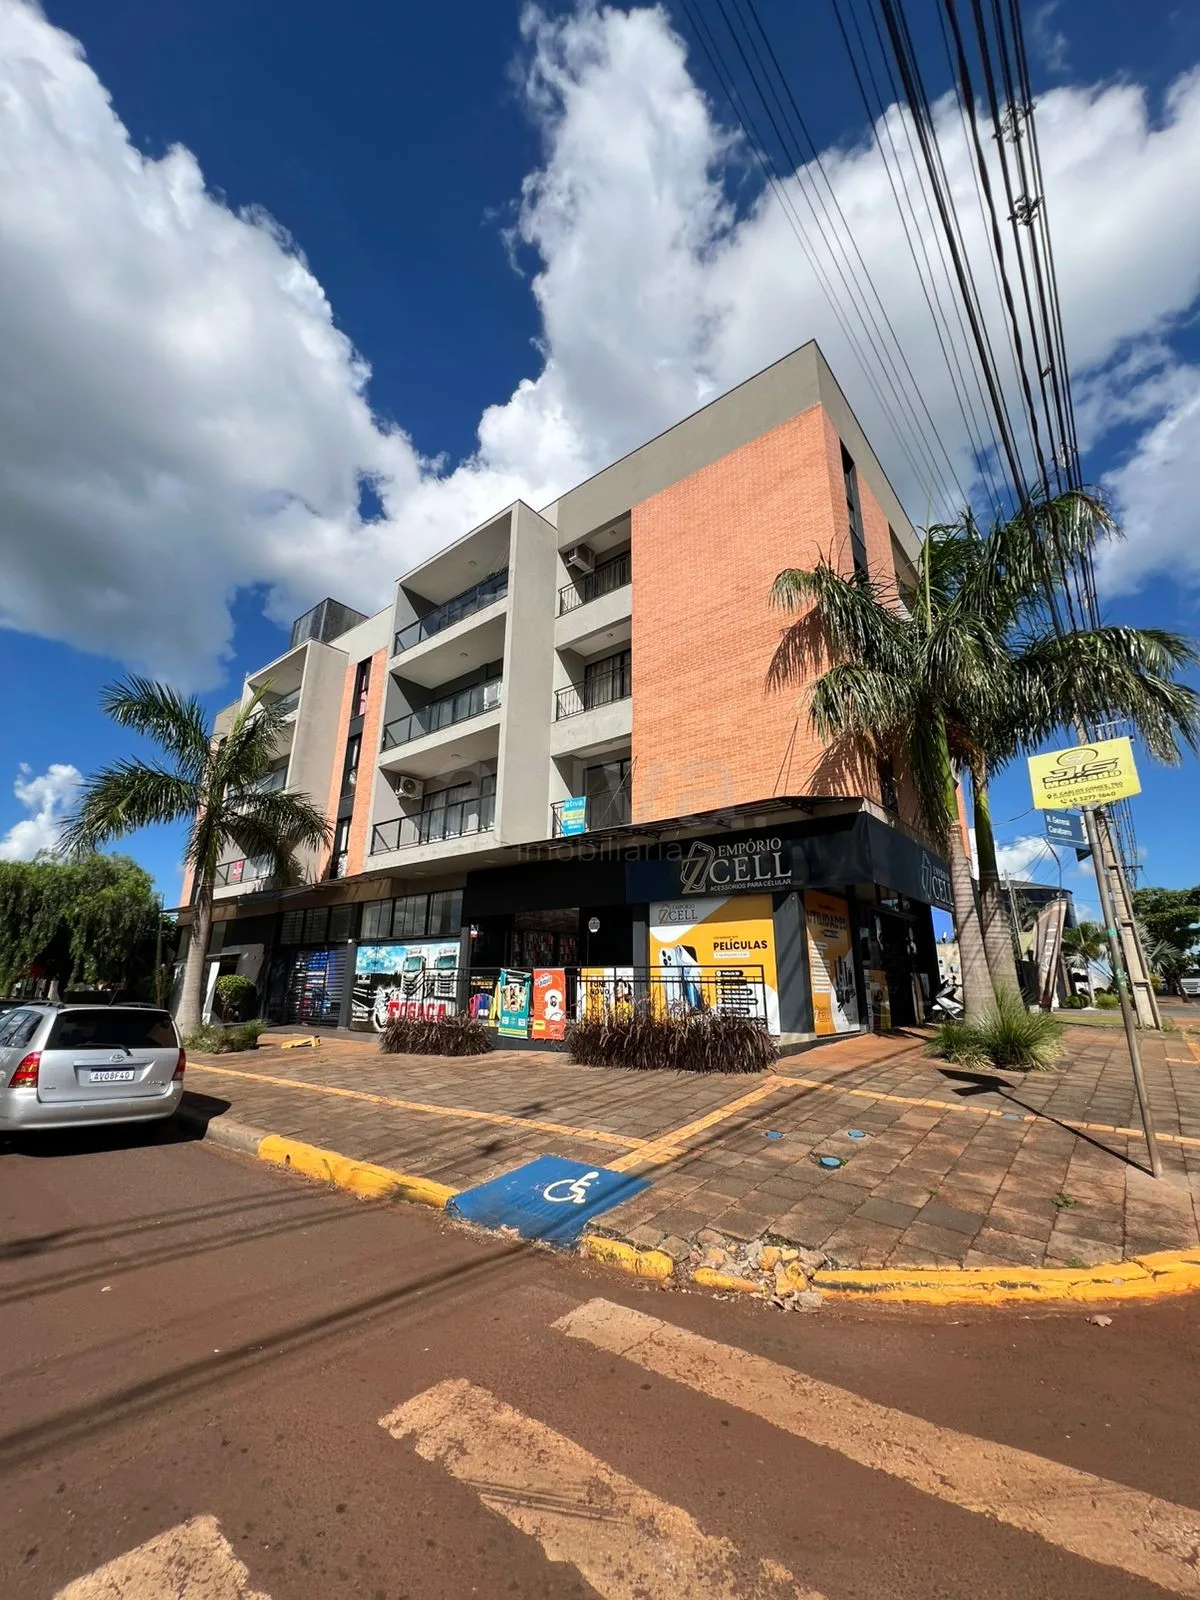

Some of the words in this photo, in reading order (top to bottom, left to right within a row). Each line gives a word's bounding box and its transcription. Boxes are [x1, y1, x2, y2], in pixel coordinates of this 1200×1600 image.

[1044, 769, 1122, 790] Mercado
[718, 837, 782, 857] EMPÓRIO
[709, 851, 792, 884] CELL
[747, 880, 763, 889] PARA
[764, 878, 792, 887] CELULAR
[713, 938, 768, 951] PELÍCULAS
